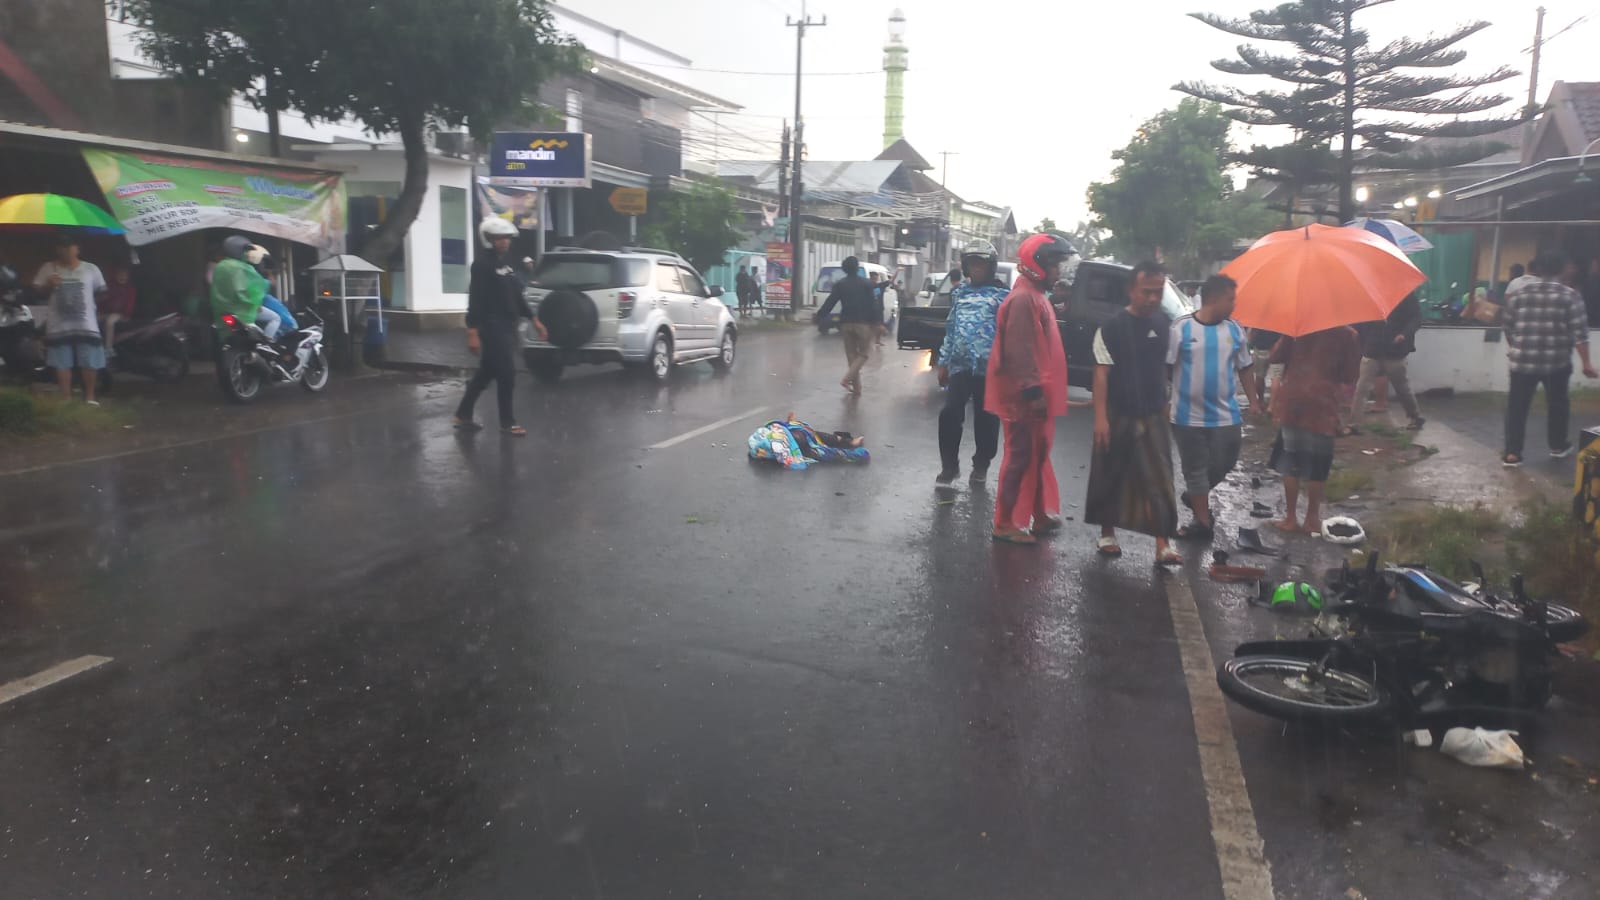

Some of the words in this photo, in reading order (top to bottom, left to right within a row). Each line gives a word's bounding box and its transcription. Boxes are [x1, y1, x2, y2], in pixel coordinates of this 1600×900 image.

[136, 202, 173, 216] SAYUR
[141, 210, 178, 226] SAYUR
[145, 224, 167, 236] MIE
[168, 217, 200, 230] REBUS
